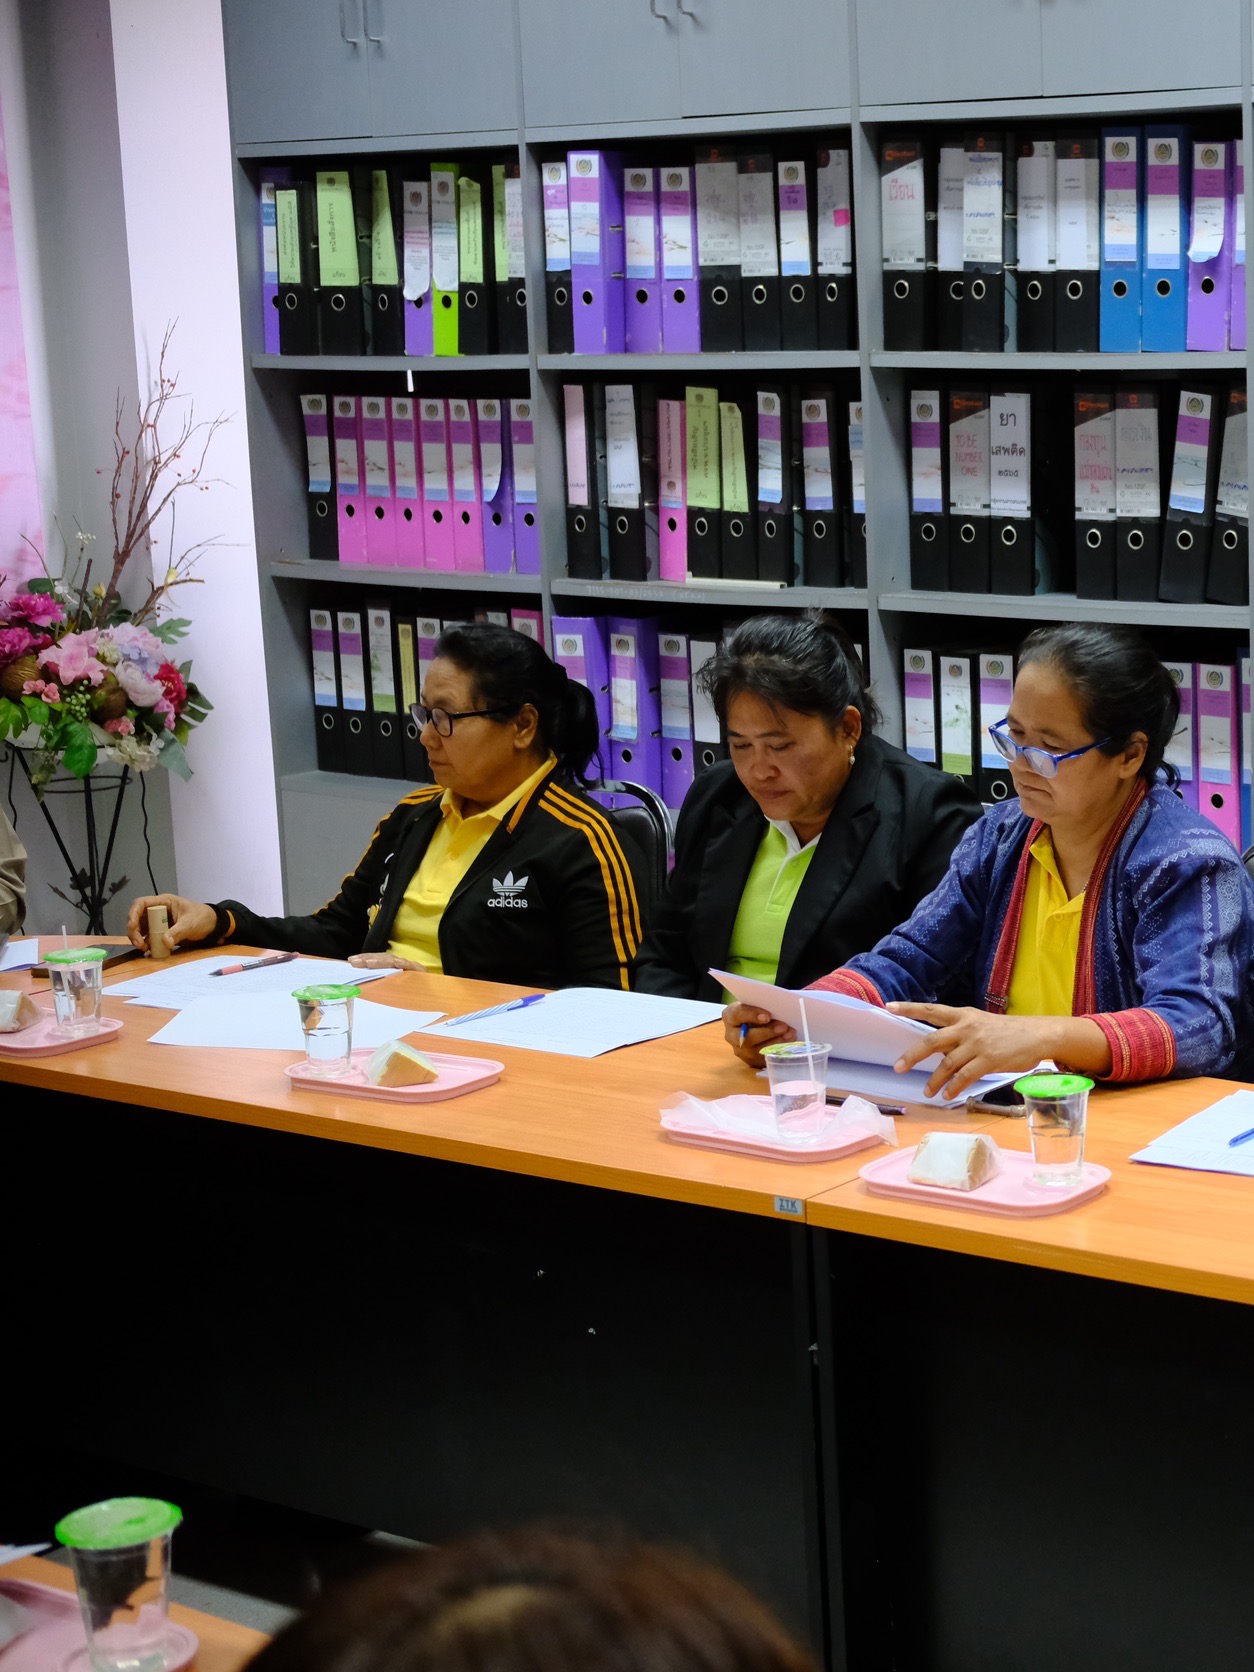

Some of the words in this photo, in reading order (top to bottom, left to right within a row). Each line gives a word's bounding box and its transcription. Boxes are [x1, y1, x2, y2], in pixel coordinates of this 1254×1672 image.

[999, 412, 1017, 427] ยา
[967, 434, 978, 448] BE
[991, 443, 1026, 457] เสพติด
[960, 465, 979, 478] ONE
[487, 897, 529, 908] adidas
